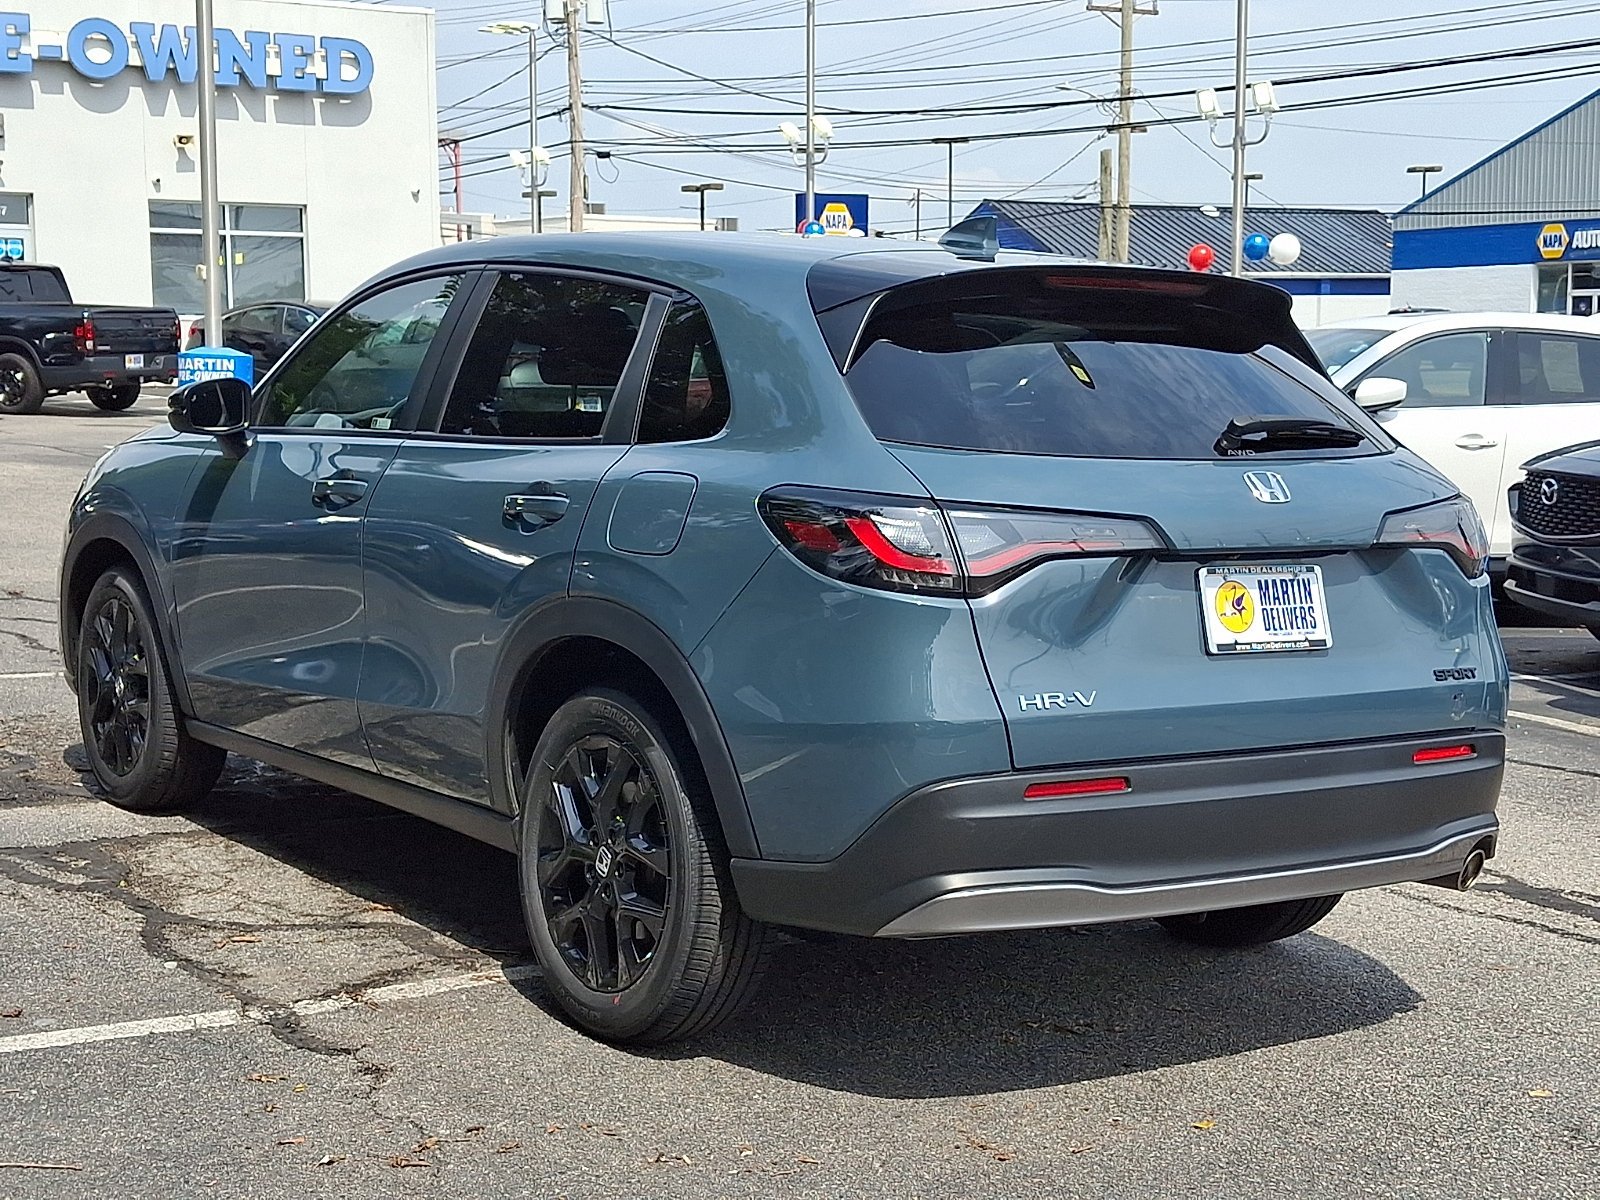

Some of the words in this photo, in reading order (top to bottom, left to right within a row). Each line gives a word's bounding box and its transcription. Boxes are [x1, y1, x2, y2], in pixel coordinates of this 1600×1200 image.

[826, 214, 847, 229] NAPA
[1542, 233, 1563, 248] NAPA
[1257, 577, 1314, 606] MARTIN
[1261, 606, 1317, 632] DELIVERS
[1433, 667, 1477, 682] SPORT
[1018, 690, 1097, 712] HR-V
